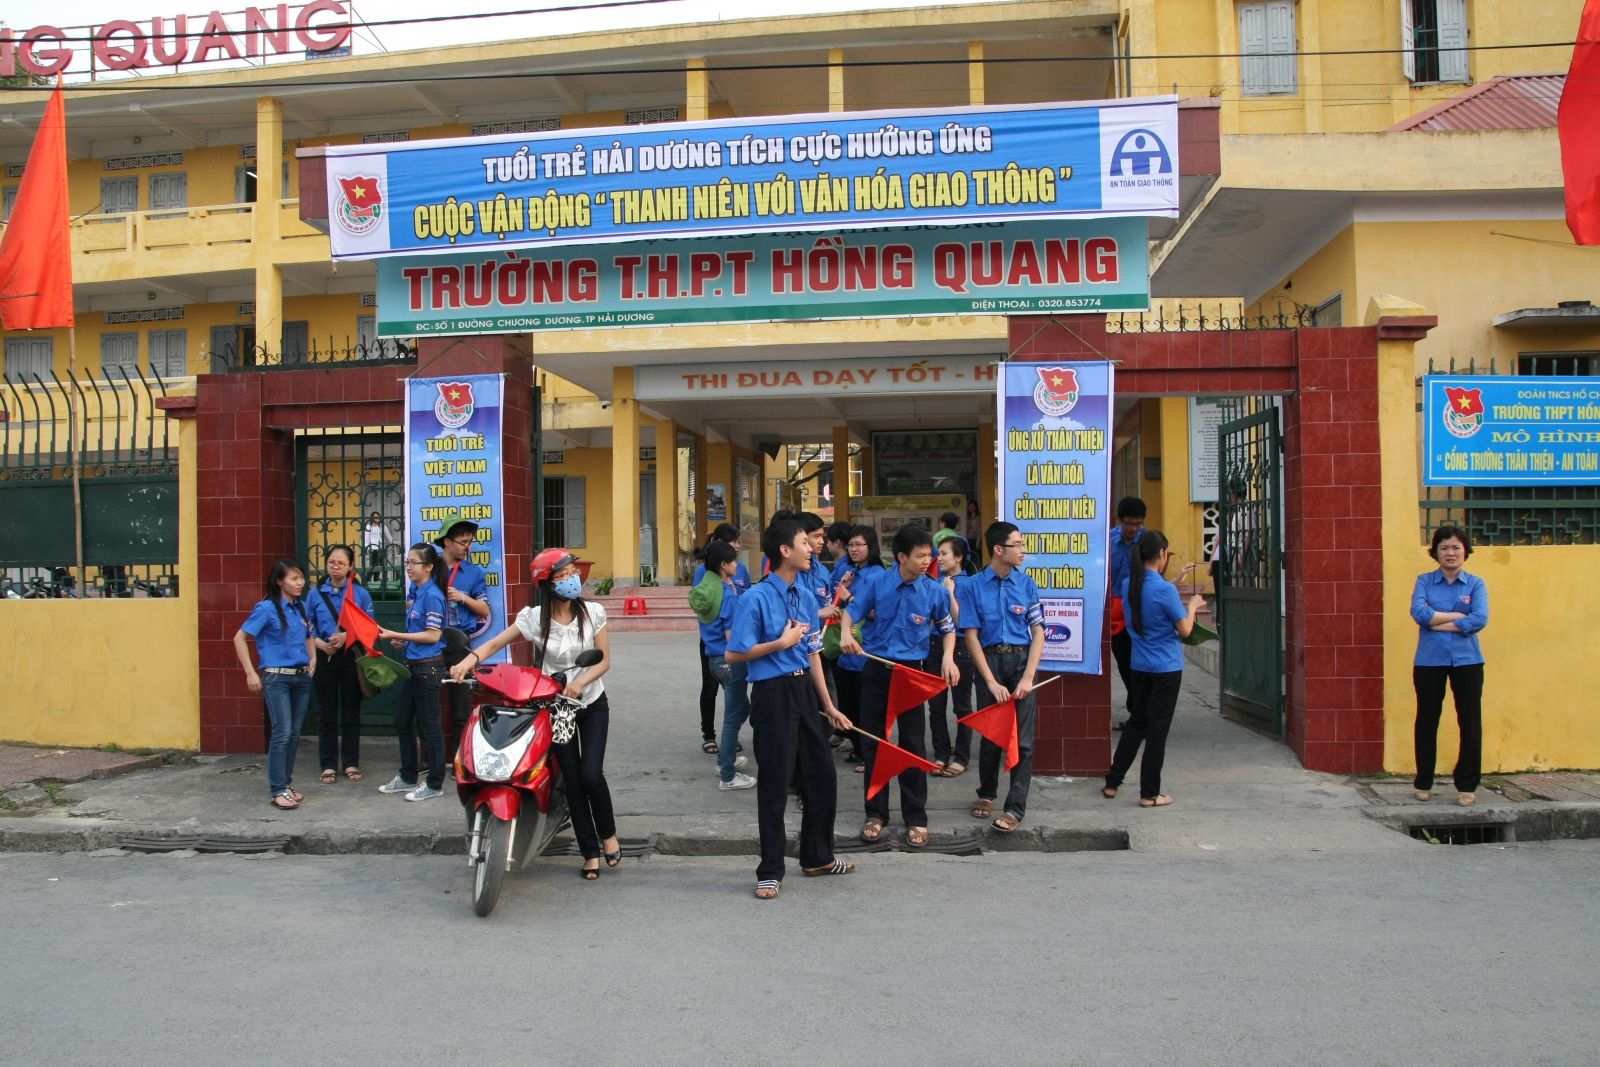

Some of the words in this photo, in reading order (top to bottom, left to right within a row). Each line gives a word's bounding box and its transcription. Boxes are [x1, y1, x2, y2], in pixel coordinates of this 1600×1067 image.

[93, 0, 351, 69] QUANG
[482, 145, 537, 184] TUỔI
[541, 145, 587, 180] TRẺ
[592, 141, 634, 175] HẢI
[639, 138, 722, 171] DƯƠNG
[726, 134, 785, 168] TÍCH
[790, 130, 843, 166] CỰC
[846, 124, 934, 158] HƯỞNG
[939, 122, 993, 155] ỨNG
[1110, 180, 1119, 188] AN
[1137, 179, 1151, 187] GIAO
[413, 196, 475, 243] CUỘC
[477, 193, 525, 240] VẬN
[528, 189, 591, 236] ĐỘNG
[693, 177, 750, 219] NIÊN
[753, 172, 795, 217] VỚI
[799, 172, 849, 214] VĂN
[854, 167, 901, 210] HÓA
[909, 169, 967, 208] GIAO
[402, 251, 599, 312] TRƯỜNG
[613, 250, 755, 301] T.H.P.T
[770, 235, 915, 295] HỒNG
[933, 236, 1120, 294] QUANG
[972, 299, 996, 310] ĐIỆN
[1038, 298, 1102, 308] 0320.853774
[451, 322, 455, 330] 1
[458, 318, 494, 329] ĐƯỜNG
[497, 317, 541, 327] CHƯƠNG
[598, 313, 615, 323] HẢI
[617, 313, 654, 322] DƯƠNG
[682, 373, 728, 390] THI
[736, 371, 804, 388] ĐUA
[813, 368, 876, 390] DẠY
[886, 360, 947, 383] TỐT
[1517, 388, 1546, 399] ĐOÀN
[1548, 390, 1571, 399] TNCS
[1573, 388, 1587, 399] HỒ
[1492, 402, 1542, 420] TRƯỜNG
[1544, 405, 1574, 420] THPT
[425, 434, 458, 452] TUỔI
[460, 433, 486, 451] TRẺ
[1008, 426, 1029, 451] ỨNG
[1031, 424, 1045, 451] XỬ
[1046, 426, 1073, 451] THÂN
[1074, 427, 1105, 455] THIỆN
[1491, 428, 1531, 443] MÔ
[1537, 429, 1600, 443] HÌNH
[424, 460, 454, 479] VIỆT
[456, 459, 487, 474] NAM
[1470, 448, 1505, 471] TRƯỜNG
[1506, 448, 1529, 471] THÂN
[1530, 448, 1554, 475] THIỆN
[1561, 451, 1574, 471] AN
[1576, 448, 1598, 471] TOÀN
[1027, 460, 1039, 485] LÀ
[1040, 460, 1061, 485] VĂN
[1062, 460, 1084, 485] HÓA
[429, 483, 452, 498] THI
[454, 482, 483, 497] ĐUA
[460, 503, 492, 521] HIỆN
[1015, 492, 1036, 520] CỦA
[1037, 498, 1071, 520] THANH
[1072, 495, 1096, 520] NIÊN
[1040, 533, 1070, 554] THAM
[1070, 533, 1089, 554] GIA
[470, 551, 490, 568] VỤ
[1049, 564, 1084, 589] THÔNG
